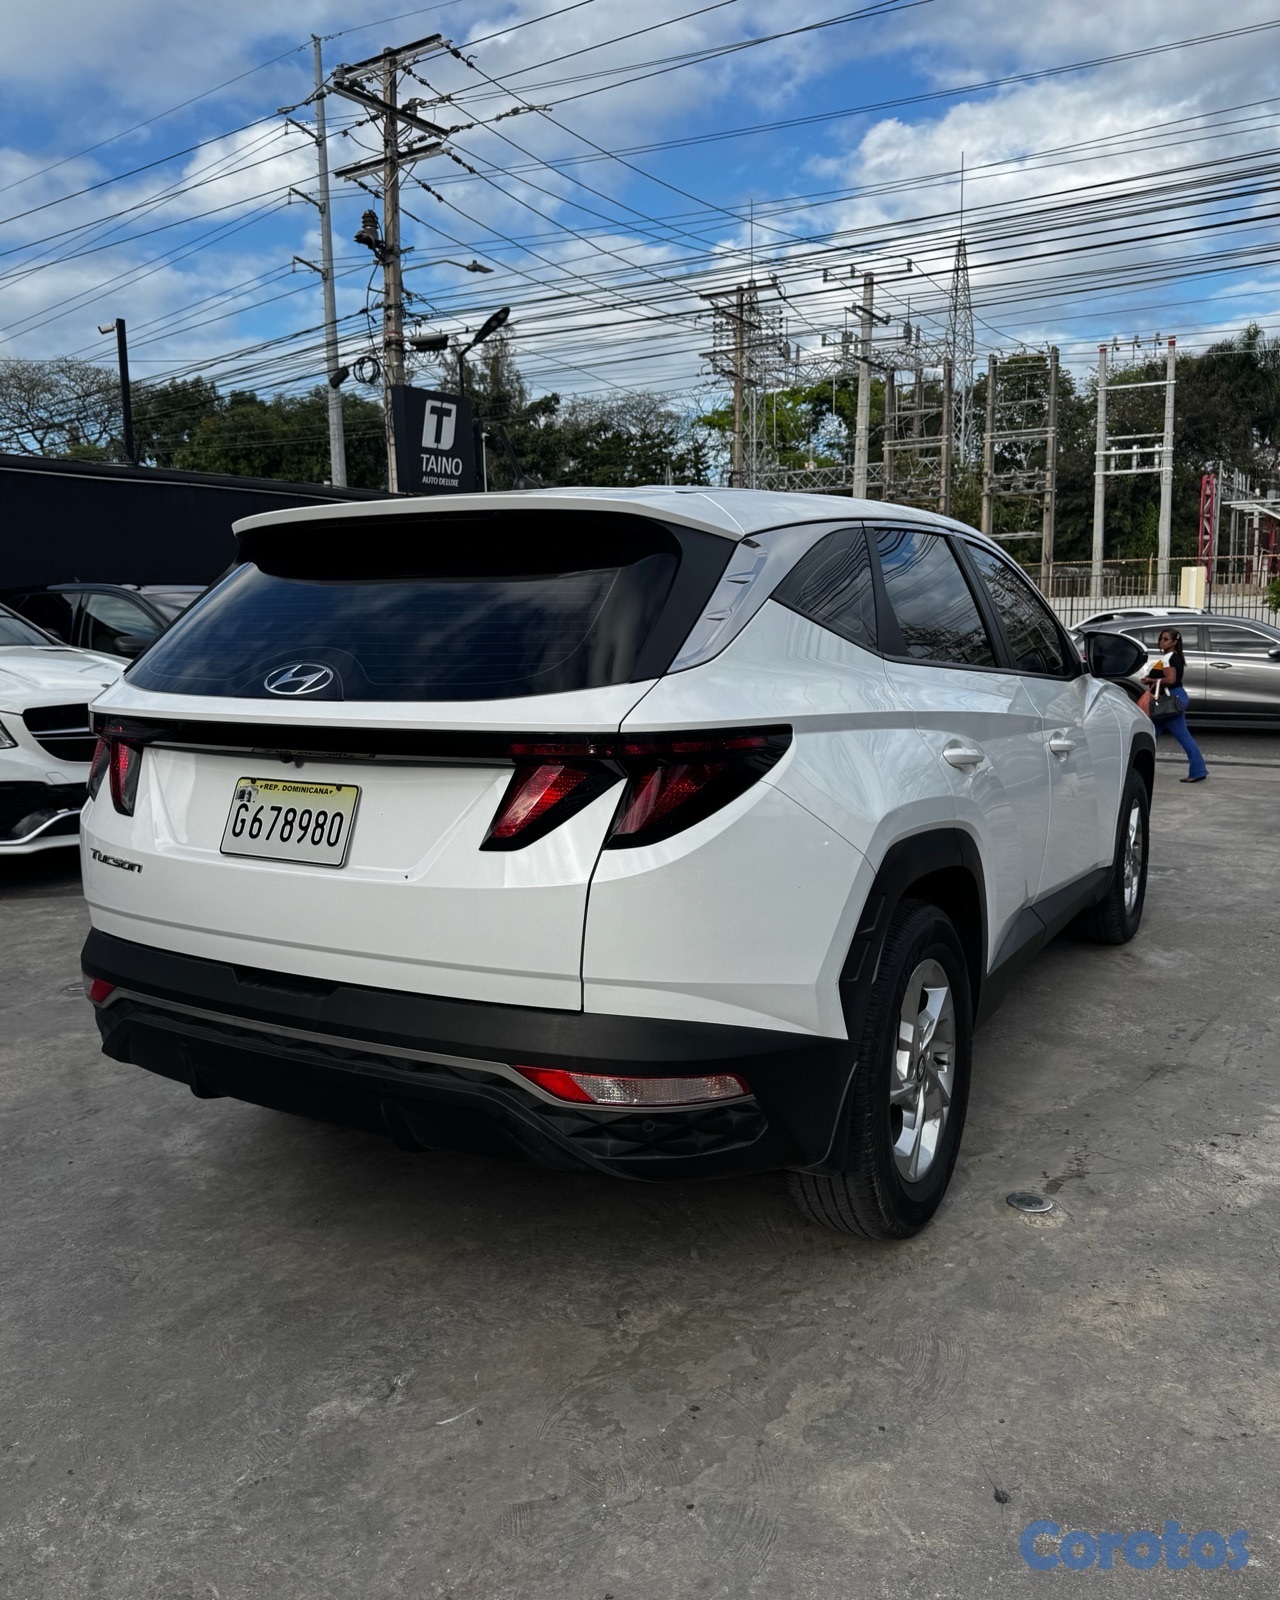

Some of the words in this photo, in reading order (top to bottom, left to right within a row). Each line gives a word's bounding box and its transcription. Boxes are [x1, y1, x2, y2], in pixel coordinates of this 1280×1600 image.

[420, 453, 463, 476] TAINO
[422, 475, 438, 485] AUTO
[439, 477, 459, 487] DELUXE
[264, 783, 280, 792] REP.
[281, 784, 329, 796] DOMINICANA
[231, 803, 344, 848] G678980
